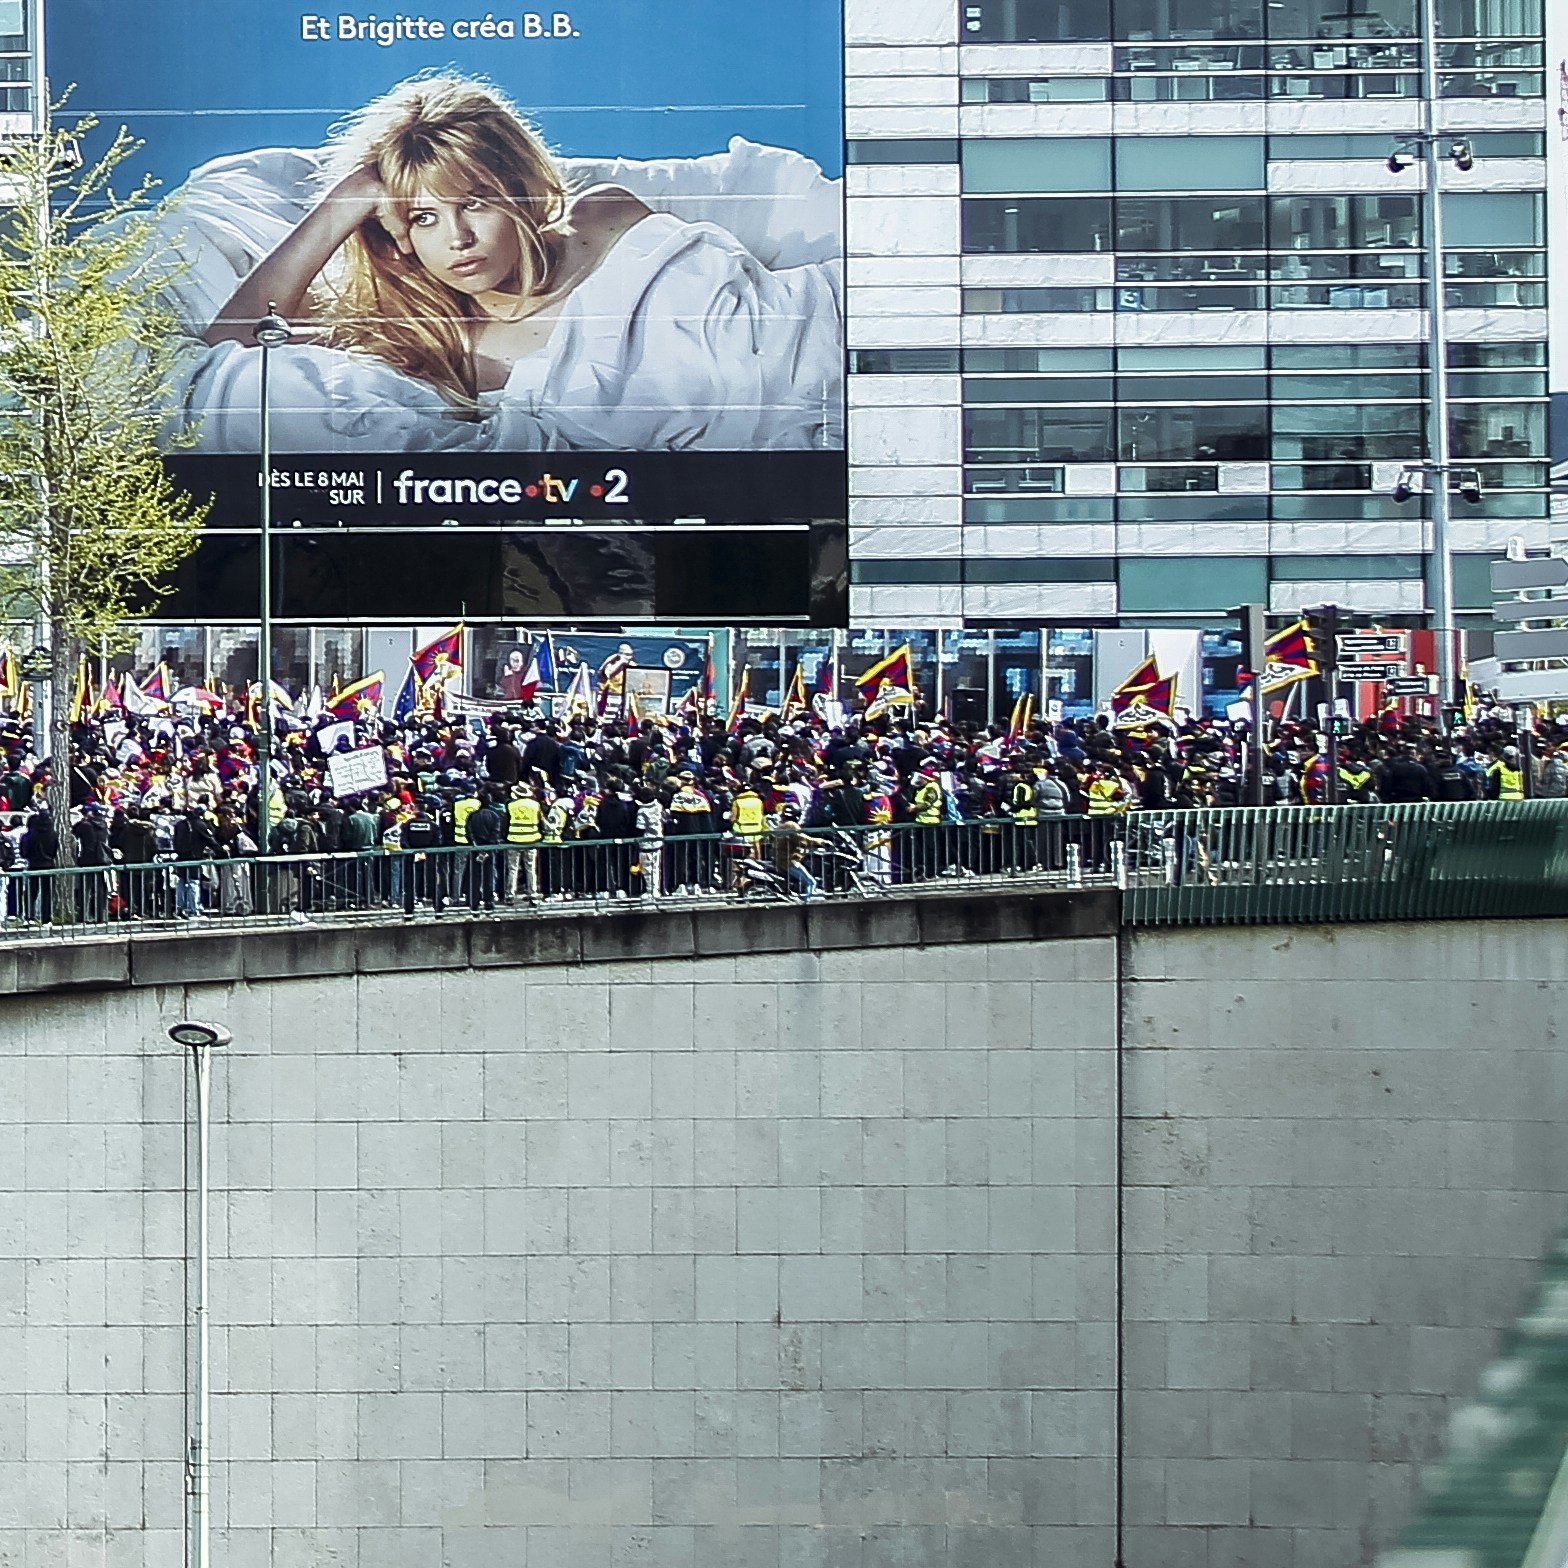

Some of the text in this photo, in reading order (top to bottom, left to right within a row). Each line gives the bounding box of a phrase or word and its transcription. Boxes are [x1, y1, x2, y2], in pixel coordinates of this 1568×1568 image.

[302, 13, 581, 47] Et Brigitte créa B.B.
[294, 471, 315, 487] LE
[317, 471, 329, 487] 8
[331, 471, 364, 487] MAI
[329, 489, 365, 505] SUR
